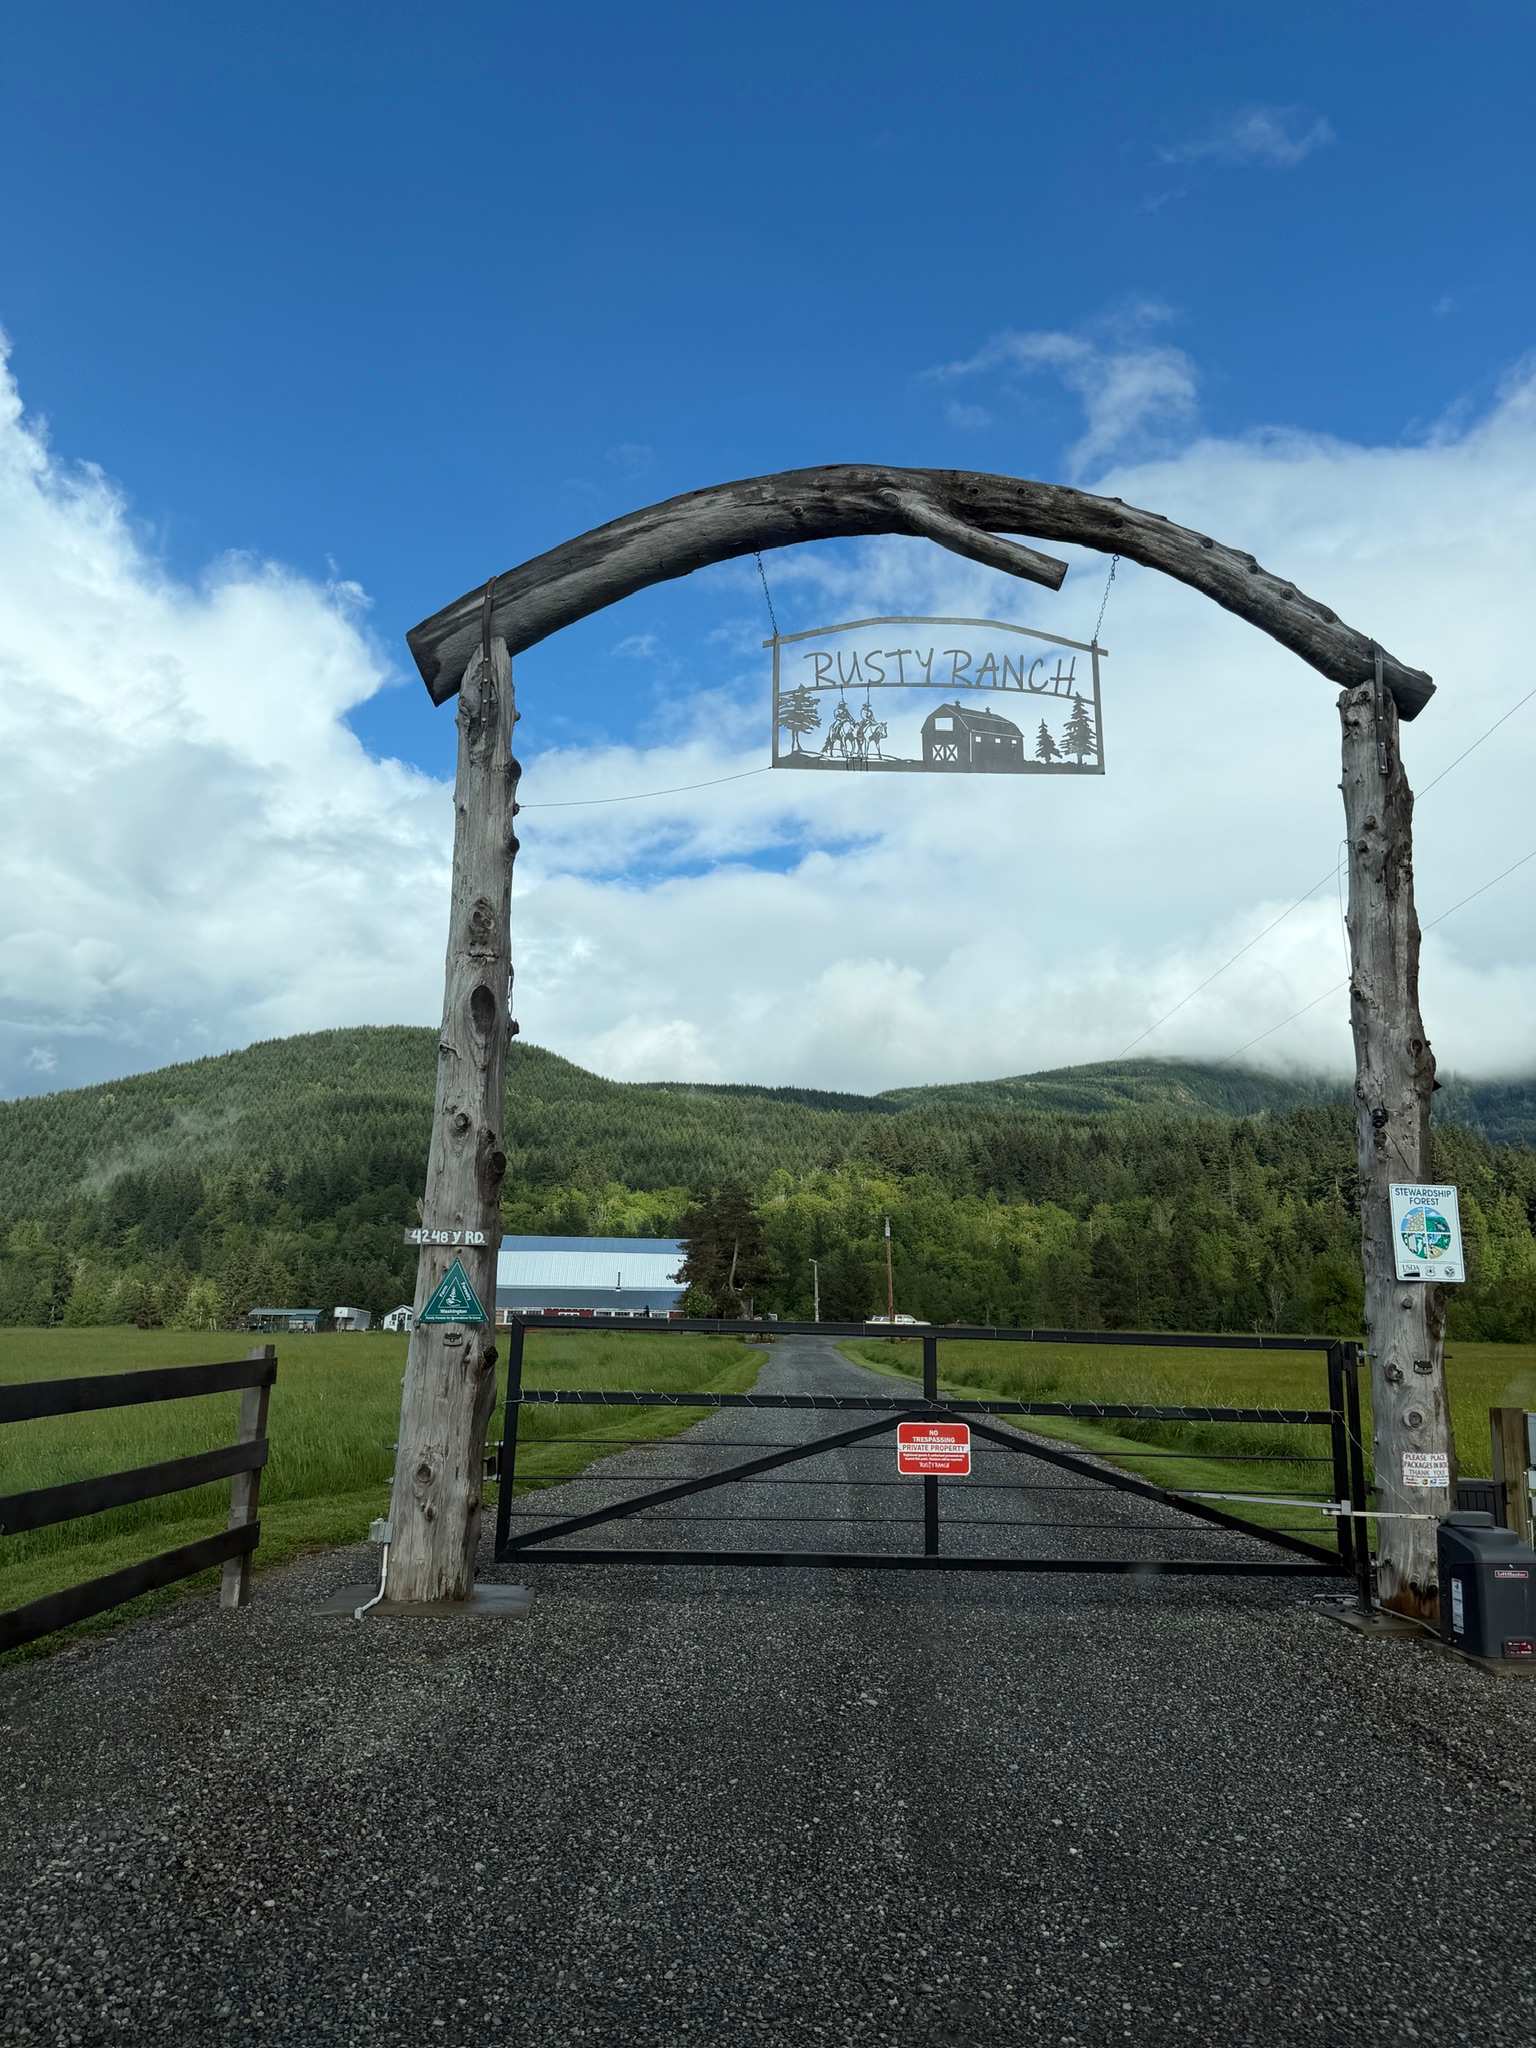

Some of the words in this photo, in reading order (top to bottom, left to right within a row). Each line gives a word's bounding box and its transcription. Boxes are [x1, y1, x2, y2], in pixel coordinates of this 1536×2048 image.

[803, 647, 934, 687] RUSTY
[943, 649, 1077, 696] RANCH
[1395, 1188, 1451, 1198] STEWARDSHIP
[1409, 1198, 1439, 1206] FOREST
[410, 1228, 449, 1244] 4248
[902, 1444, 929, 1452] PRIVATE
[930, 1444, 965, 1452] PROPERTY
